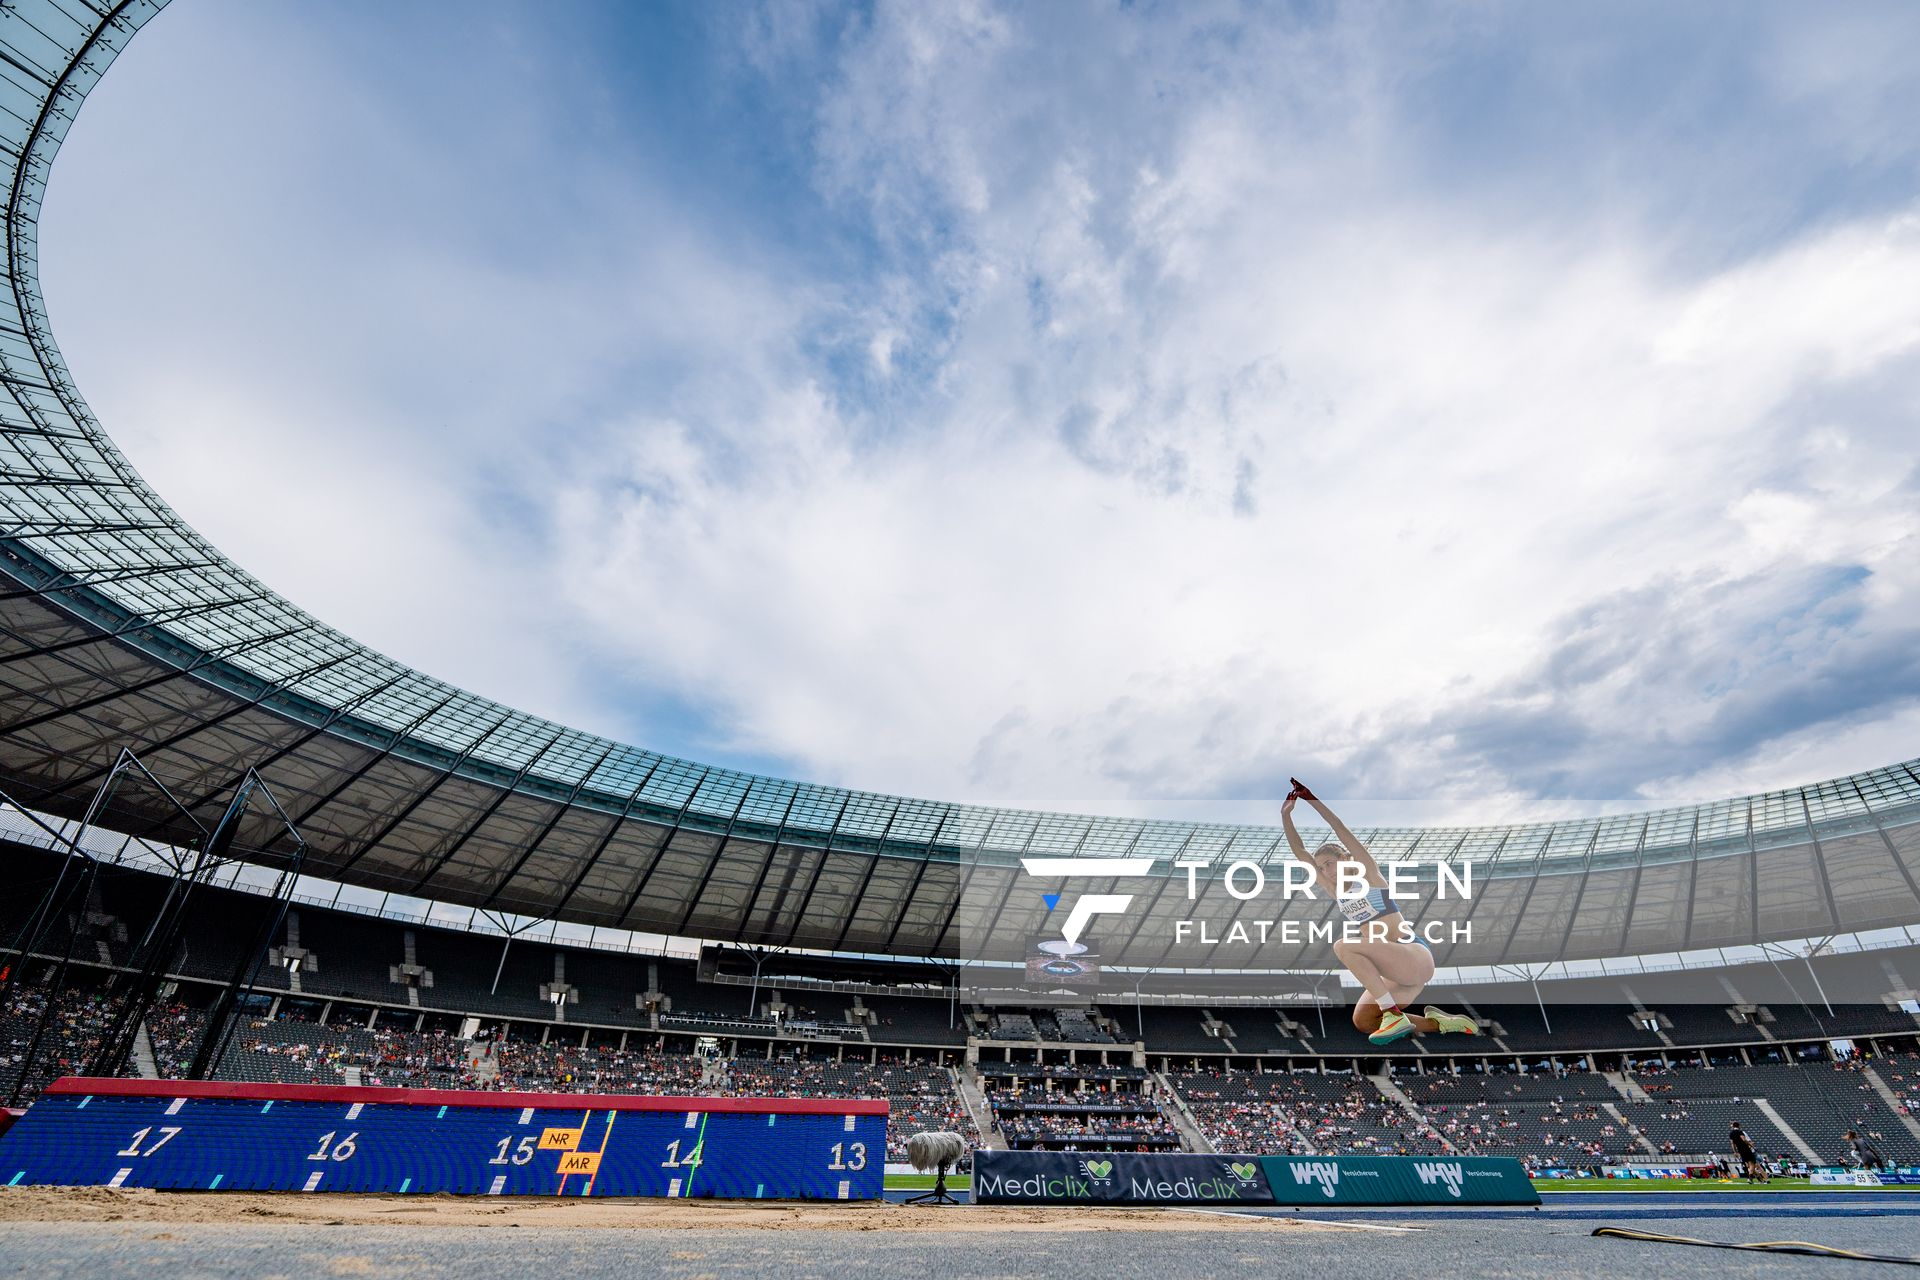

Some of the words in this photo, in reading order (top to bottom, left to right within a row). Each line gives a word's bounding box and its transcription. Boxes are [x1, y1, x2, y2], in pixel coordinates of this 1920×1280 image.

[117, 1126, 183, 1157] 17
[307, 1131, 359, 1162] 16
[489, 1135, 538, 1166] 15
[548, 1133, 571, 1146] NR
[662, 1139, 704, 1168] 14
[565, 1157, 590, 1169] MR
[828, 1143, 867, 1171] 13
[979, 1174, 1091, 1197] Mediclix
[1132, 1177, 1240, 1199] Mediclix
